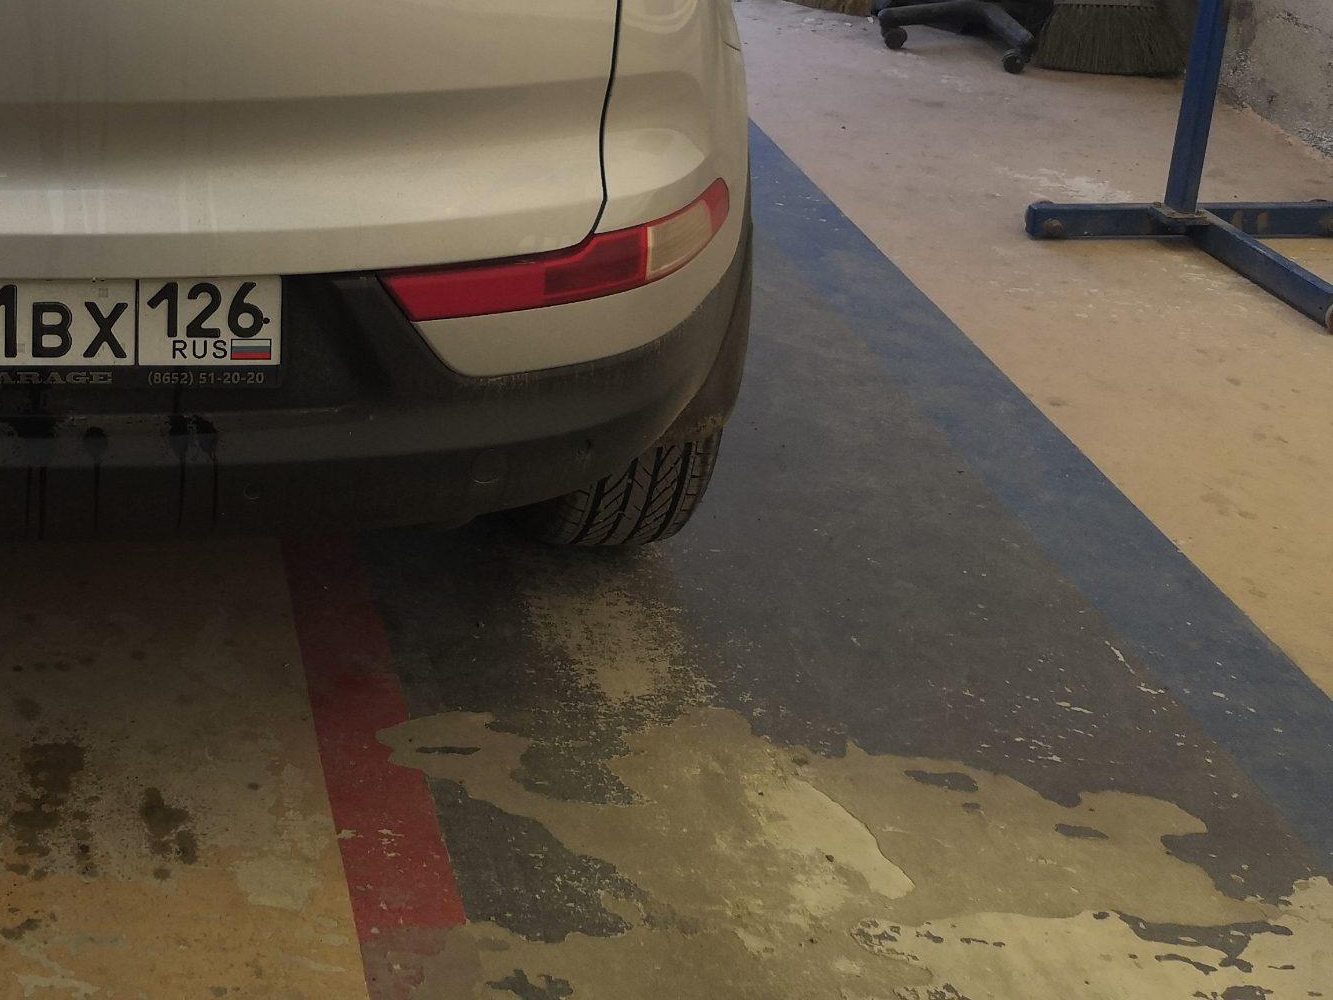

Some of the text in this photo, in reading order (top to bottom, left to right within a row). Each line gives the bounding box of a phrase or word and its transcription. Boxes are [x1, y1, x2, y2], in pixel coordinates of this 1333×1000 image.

[147, 282, 264, 338] 126
[172, 339, 227, 359] RUS
[148, 371, 265, 385] (8652) 51-20-20
